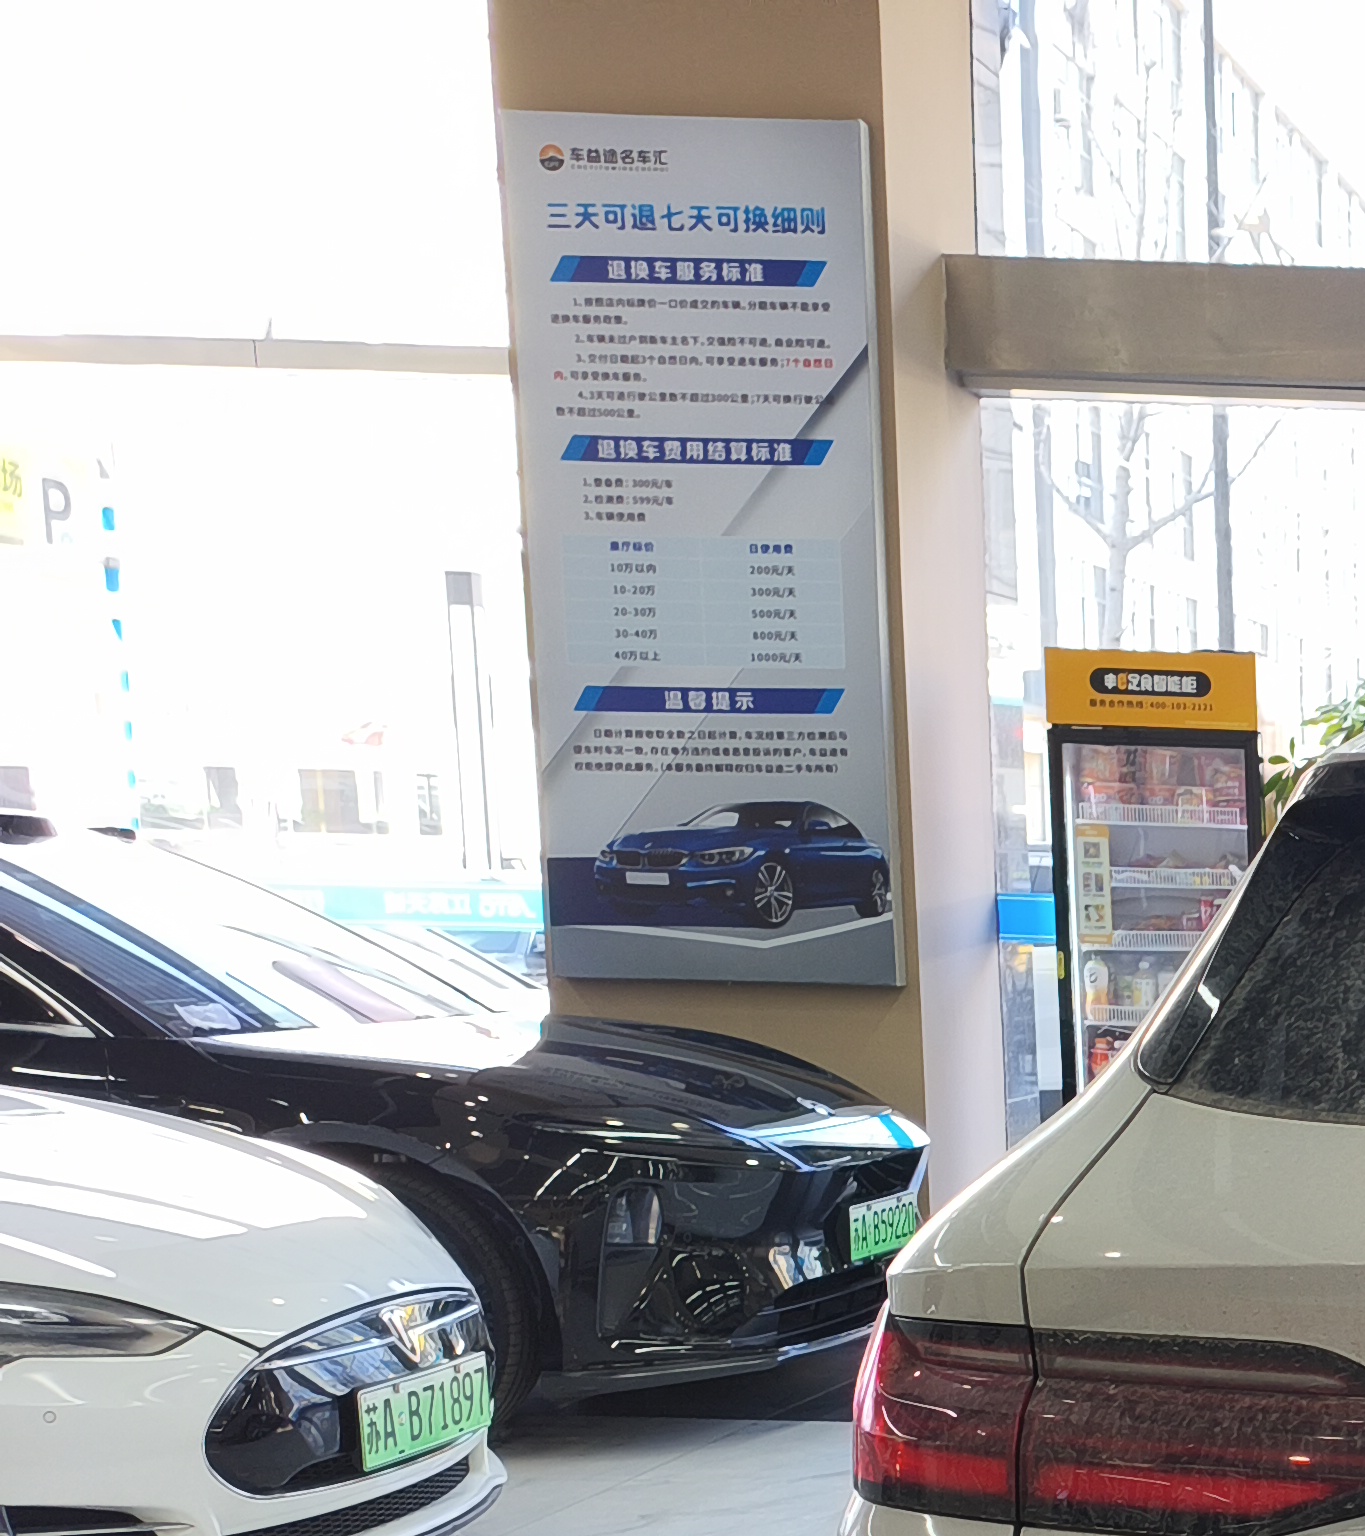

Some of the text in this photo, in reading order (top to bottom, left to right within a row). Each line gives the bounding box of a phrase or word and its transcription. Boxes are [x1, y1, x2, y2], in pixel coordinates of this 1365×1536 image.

[546, 203, 827, 235] 三天可退七天可换细则
[607, 259, 765, 283] 退换车服务标准
[597, 439, 793, 462] 退换车费用结算标准
[41, 477, 72, 545] P
[610, 562, 657, 575] 10万以内
[612, 584, 656, 596] 10-20万
[613, 606, 657, 618] 20-30万
[614, 628, 658, 640] 30-40万
[614, 650, 661, 662] 40万以上
[664, 690, 754, 711] 温馨提示
